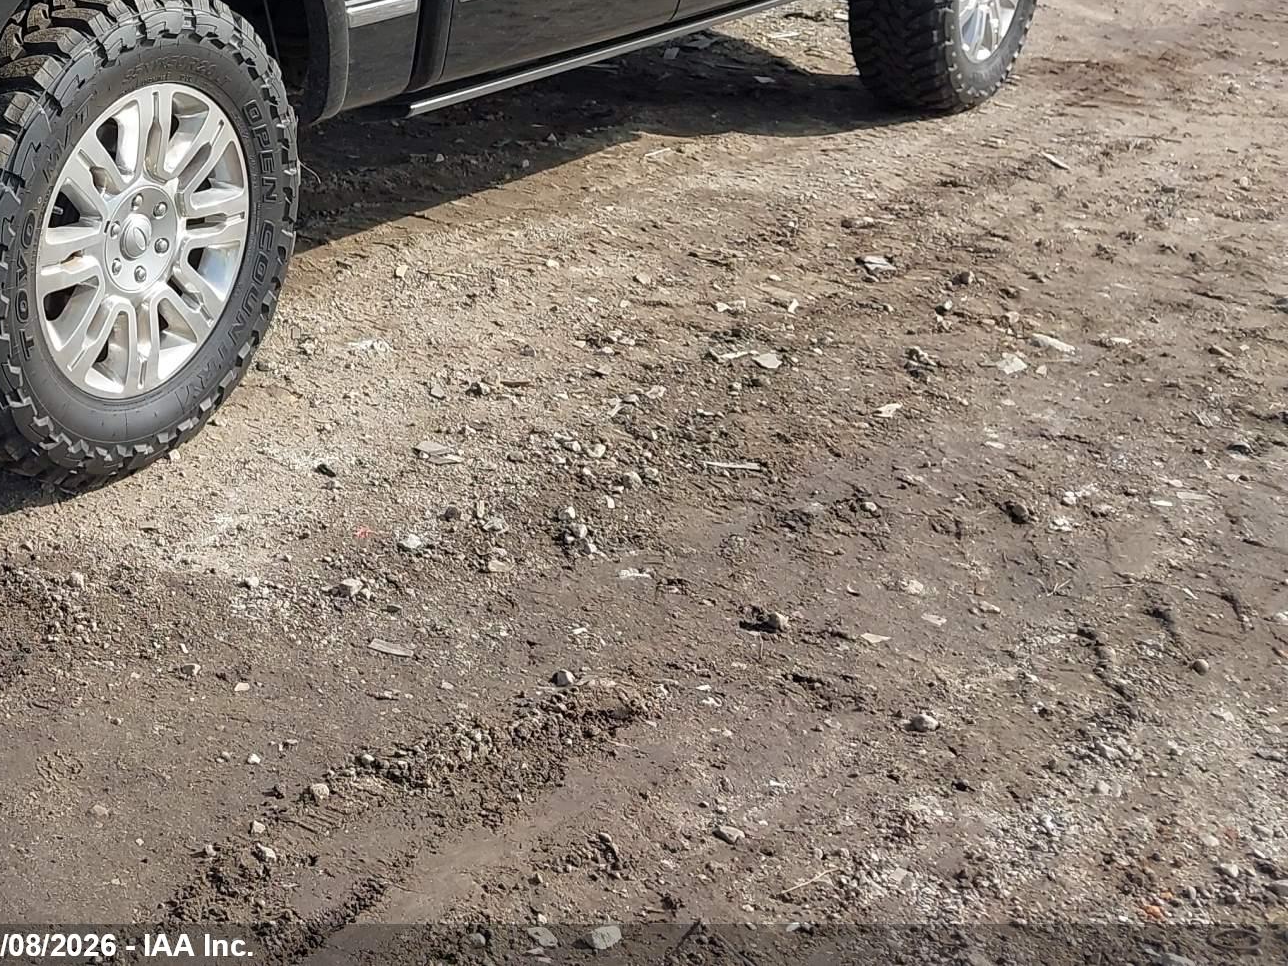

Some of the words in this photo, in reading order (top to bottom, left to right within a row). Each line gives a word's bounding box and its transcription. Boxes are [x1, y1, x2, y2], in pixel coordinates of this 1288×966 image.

[242, 98, 279, 204] OPEN
[15, 209, 37, 361] TOYO
[174, 219, 275, 414] COUNTRY
